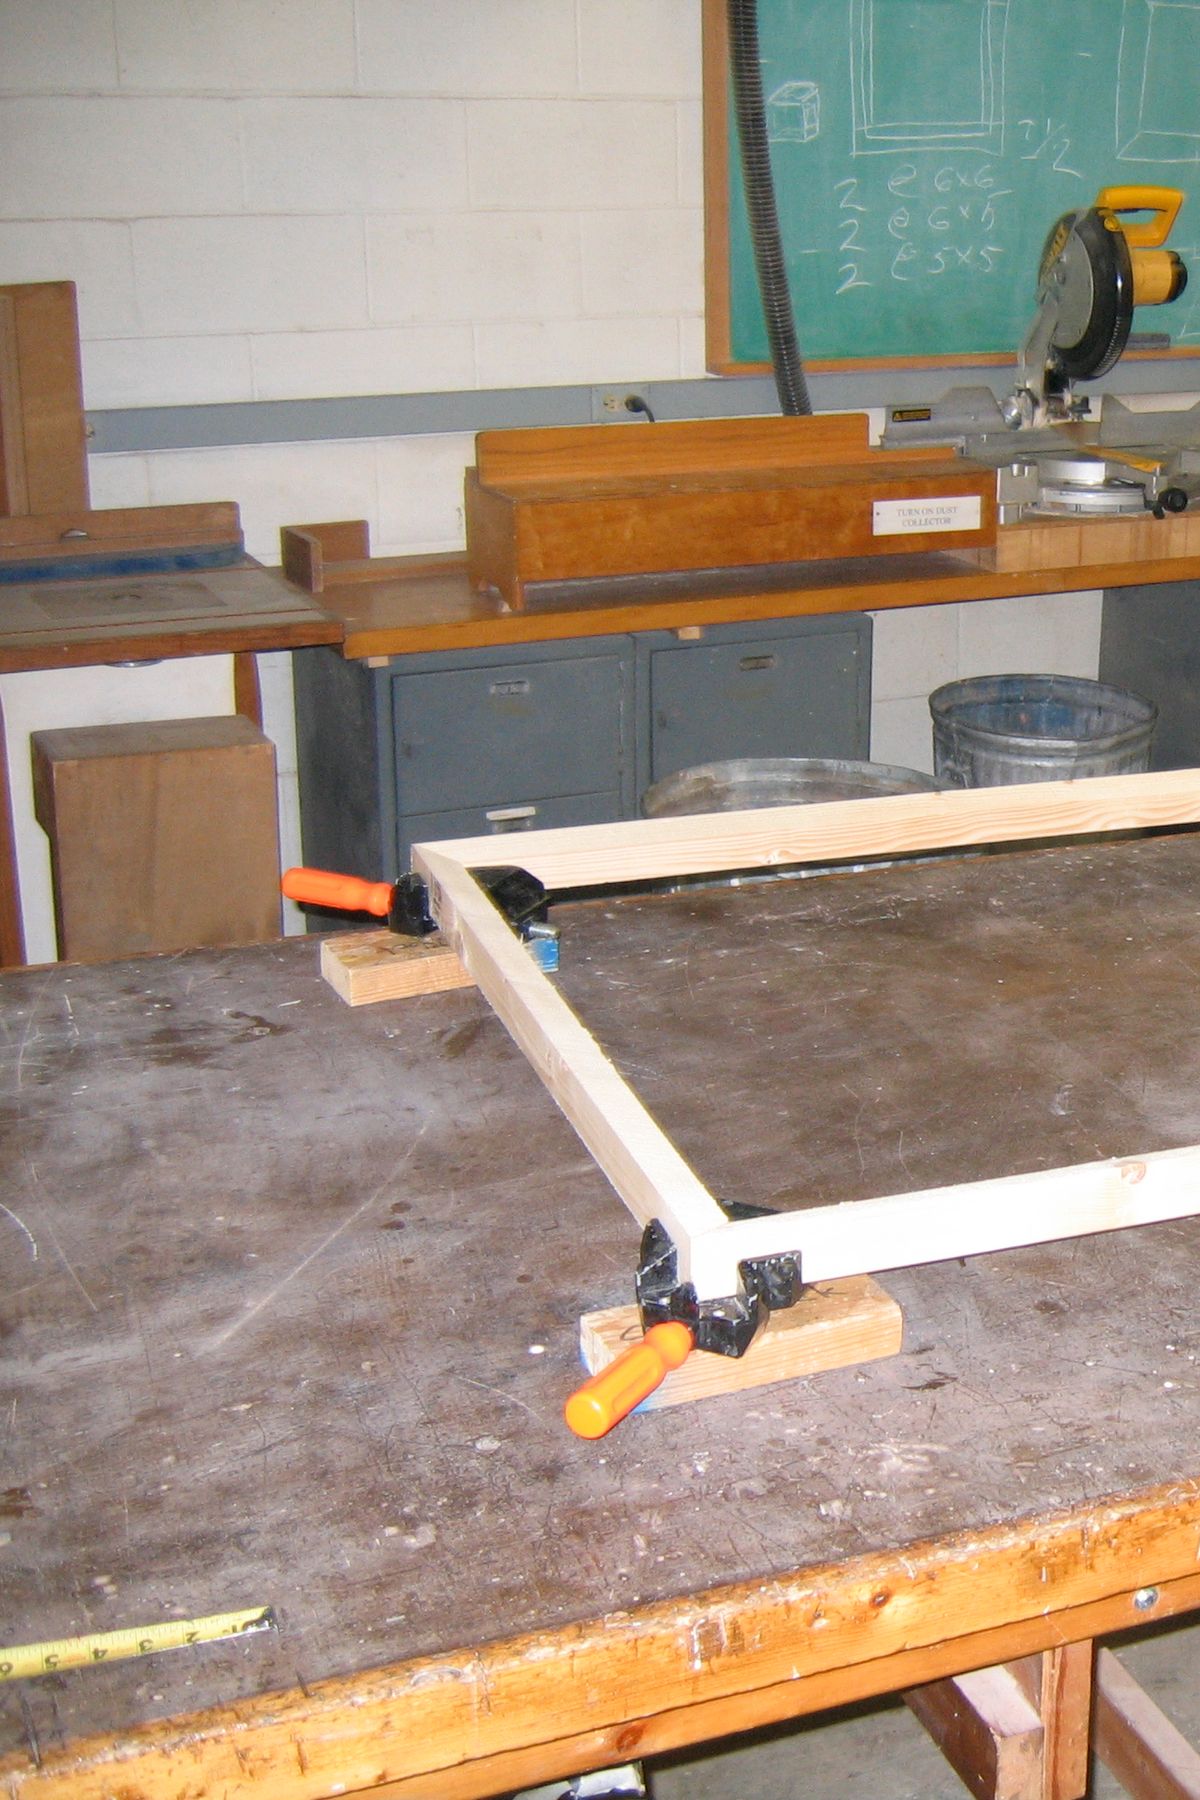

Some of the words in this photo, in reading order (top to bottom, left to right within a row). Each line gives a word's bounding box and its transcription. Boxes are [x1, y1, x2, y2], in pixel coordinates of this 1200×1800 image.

[895, 507, 920, 517] TURN
[921, 507, 934, 516] ON
[935, 505, 958, 515] DUST
[901, 517, 952, 528] COLLECTOR
[138, 1638, 154, 1653] 3
[91, 1647, 109, 1660] 4
[44, 1653, 60, 1670] 5
